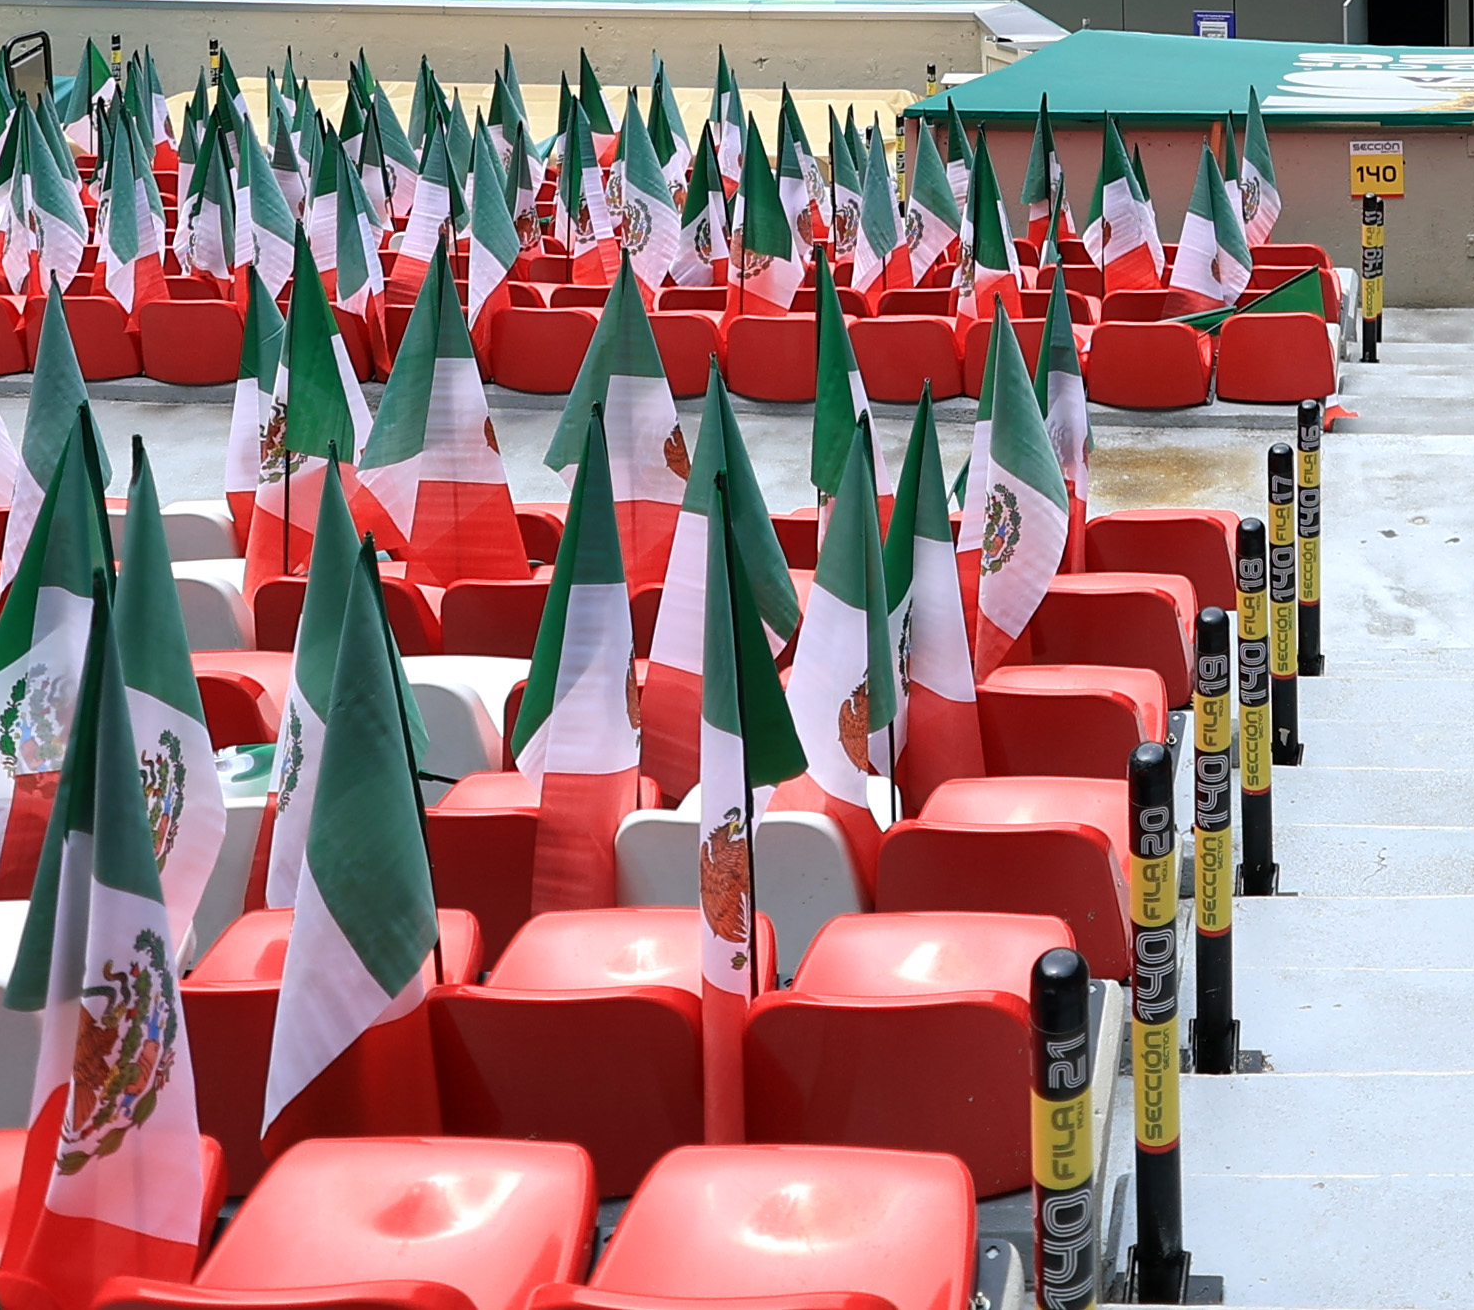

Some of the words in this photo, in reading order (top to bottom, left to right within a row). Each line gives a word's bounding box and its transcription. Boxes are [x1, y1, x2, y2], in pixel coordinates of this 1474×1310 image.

[1352, 141, 1400, 151] SECCIÓN
[1356, 165, 1397, 183] 140
[1364, 211, 1377, 223] 11
[1364, 248, 1377, 278] 140
[1301, 425, 1320, 451] 16
[1270, 474, 1293, 504] 17
[1304, 453, 1314, 484] FILA
[1276, 507, 1287, 542] FILA
[1299, 488, 1320, 538] 140
[1238, 557, 1264, 592] 18
[1270, 544, 1295, 601] 140
[1303, 542, 1314, 599] SECCIÓN
[1244, 595, 1256, 637] FILA
[1278, 606, 1288, 672] SECCIÓN
[1198, 654, 1228, 696] 19
[1240, 641, 1267, 705] 140
[1203, 700, 1217, 748] FILA
[1247, 707, 1259, 787] SECCIÓN
[1197, 754, 1228, 830] 140
[1139, 804, 1171, 857] 20
[1142, 862, 1162, 923] FILA
[1202, 835, 1217, 927] SECCIÓN
[1136, 926, 1176, 1022] 140
[1046, 1031, 1087, 1090] 21
[1143, 1030, 1165, 1141] SECCIÓN
[1050, 1104, 1077, 1181] FILA
[1042, 1187, 1094, 1310] 140
